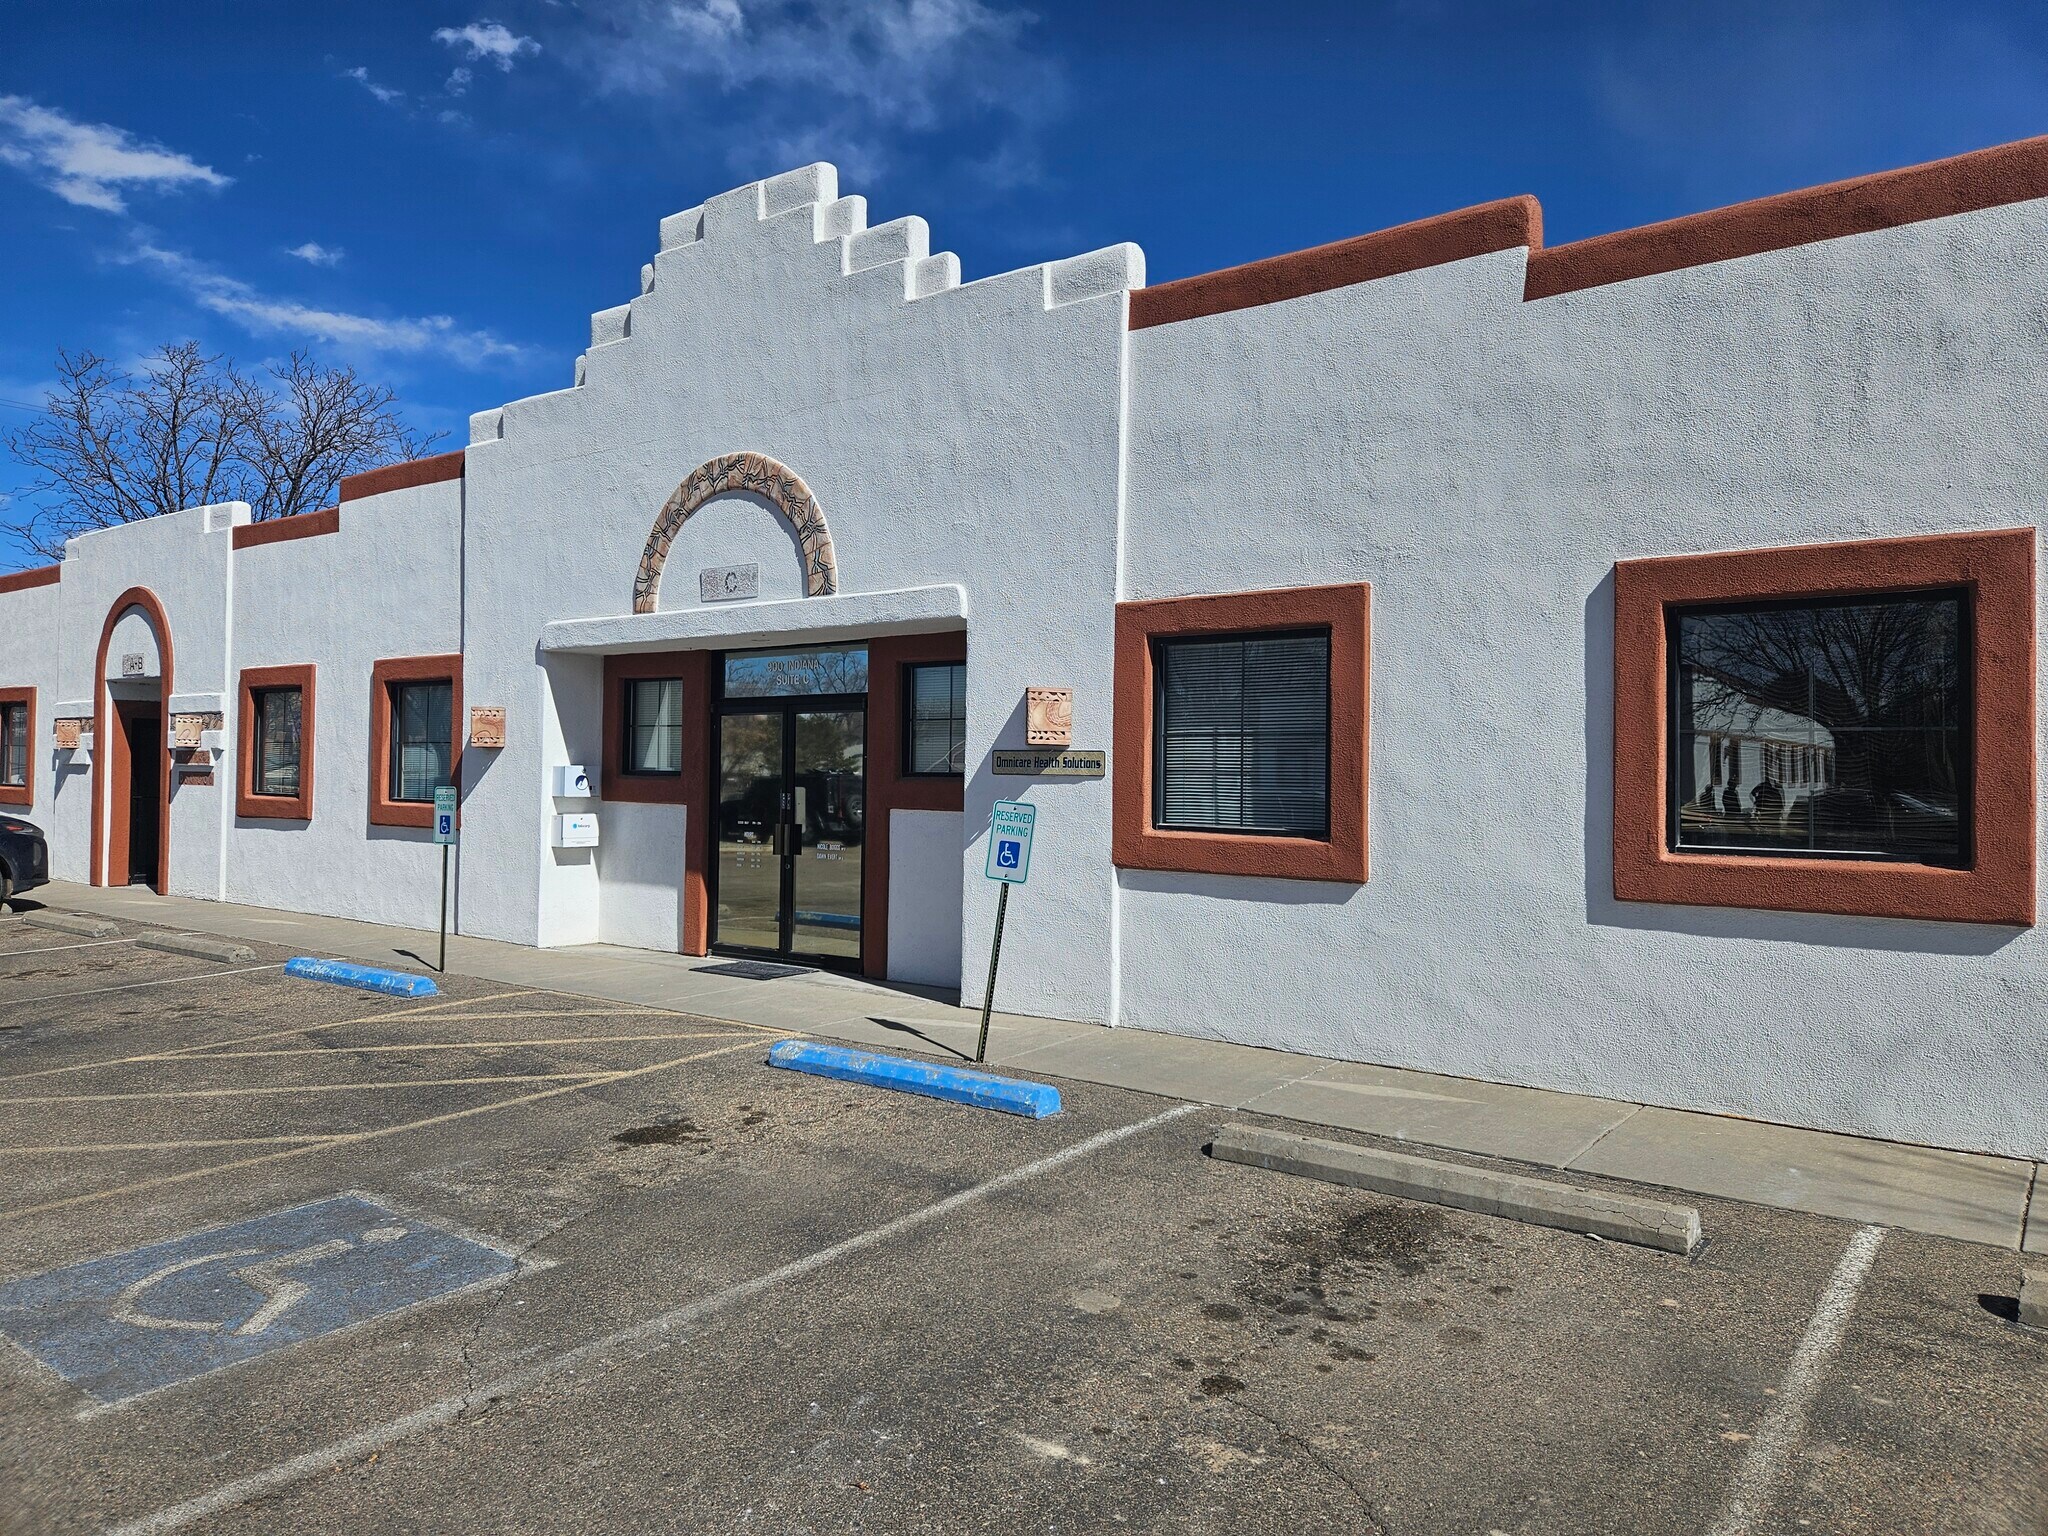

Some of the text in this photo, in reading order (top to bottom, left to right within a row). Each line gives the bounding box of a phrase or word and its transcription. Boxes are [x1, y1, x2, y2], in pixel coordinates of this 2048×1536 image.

[787, 660, 819, 671] INDIANA
[776, 674, 810, 686] SUITE C
[996, 756, 1101, 769] Omnicare Health Solutions
[437, 803, 454, 812] PARKING
[995, 810, 1032, 824] RESERVED
[996, 824, 1028, 837] PARKING
